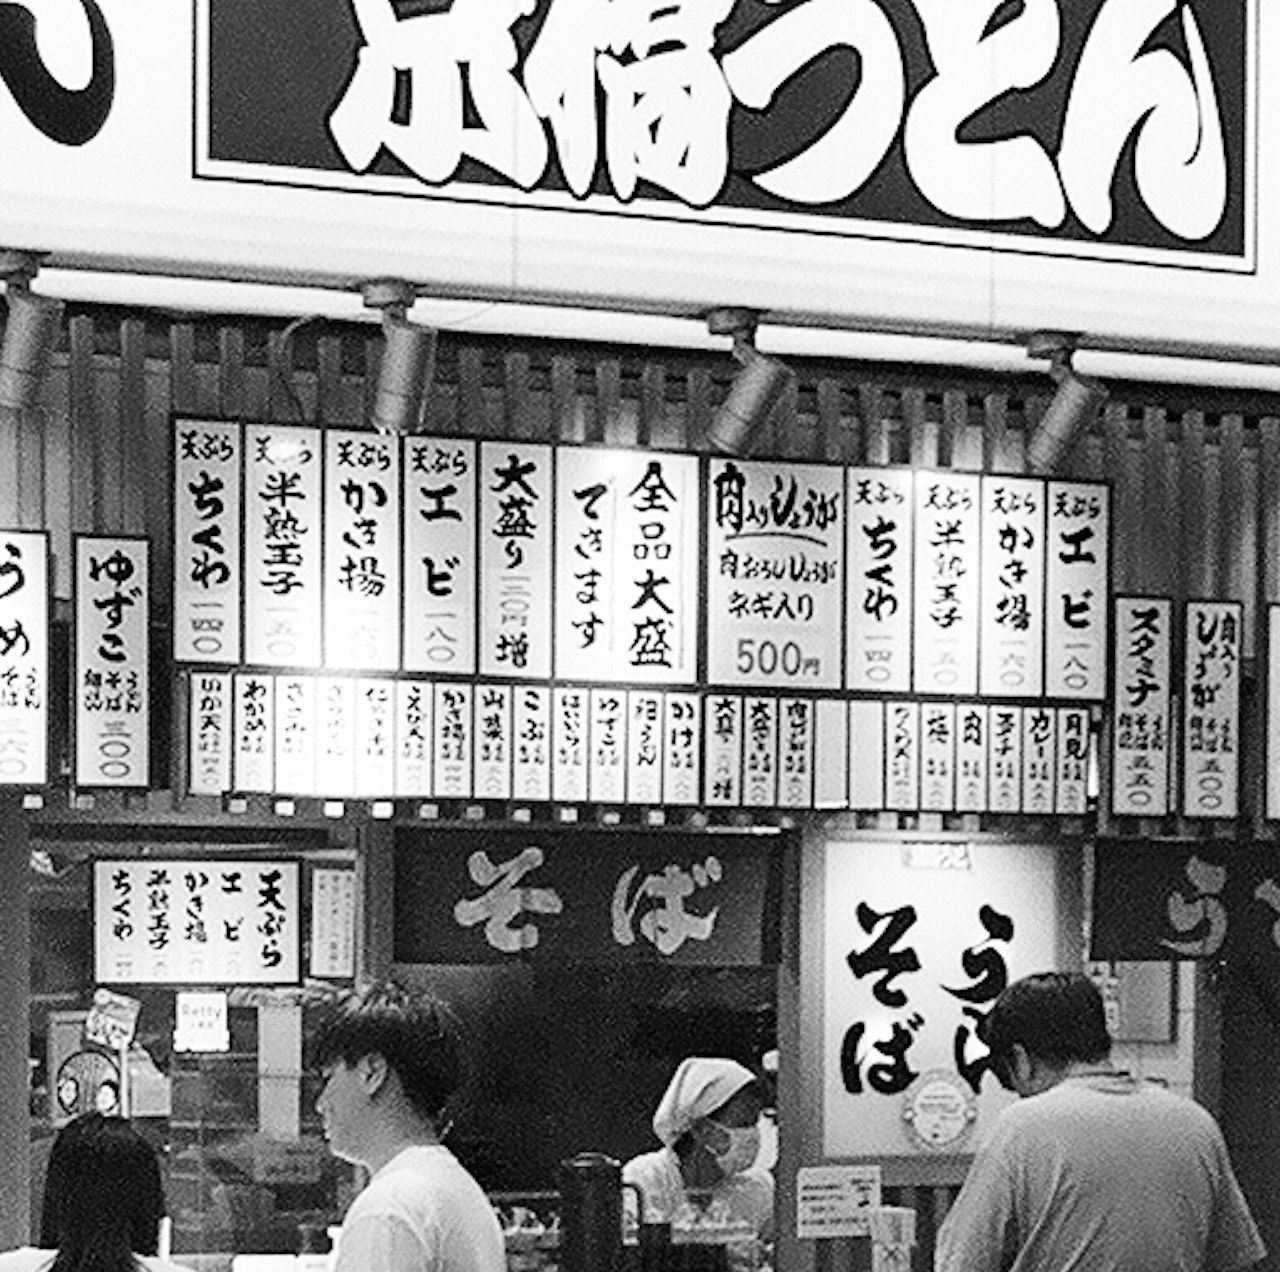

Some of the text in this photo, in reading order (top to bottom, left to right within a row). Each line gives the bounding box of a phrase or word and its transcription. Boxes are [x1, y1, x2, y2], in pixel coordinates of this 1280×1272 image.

[189, 471, 231, 589] ちくわ
[258, 472, 308, 595] 半熟玉子
[337, 479, 388, 597] かき揚
[419, 484, 463, 596] エビ
[628, 460, 677, 669] 全品大盛
[863, 516, 898, 622] ちくわ
[1059, 527, 1096, 629] エビ
[89, 550, 142, 662] ゆずこ
[729, 592, 815, 621] ネギ入り
[737, 639, 821, 676] 500円
[1126, 607, 1160, 707] スタミナ
[112, 870, 133, 941] ちくわ
[184, 872, 208, 943] かき揚
[221, 871, 243, 942] エビ
[257, 870, 286, 967] 天ぷら
[453, 846, 722, 956] そば
[840, 900, 925, 1095] そば
